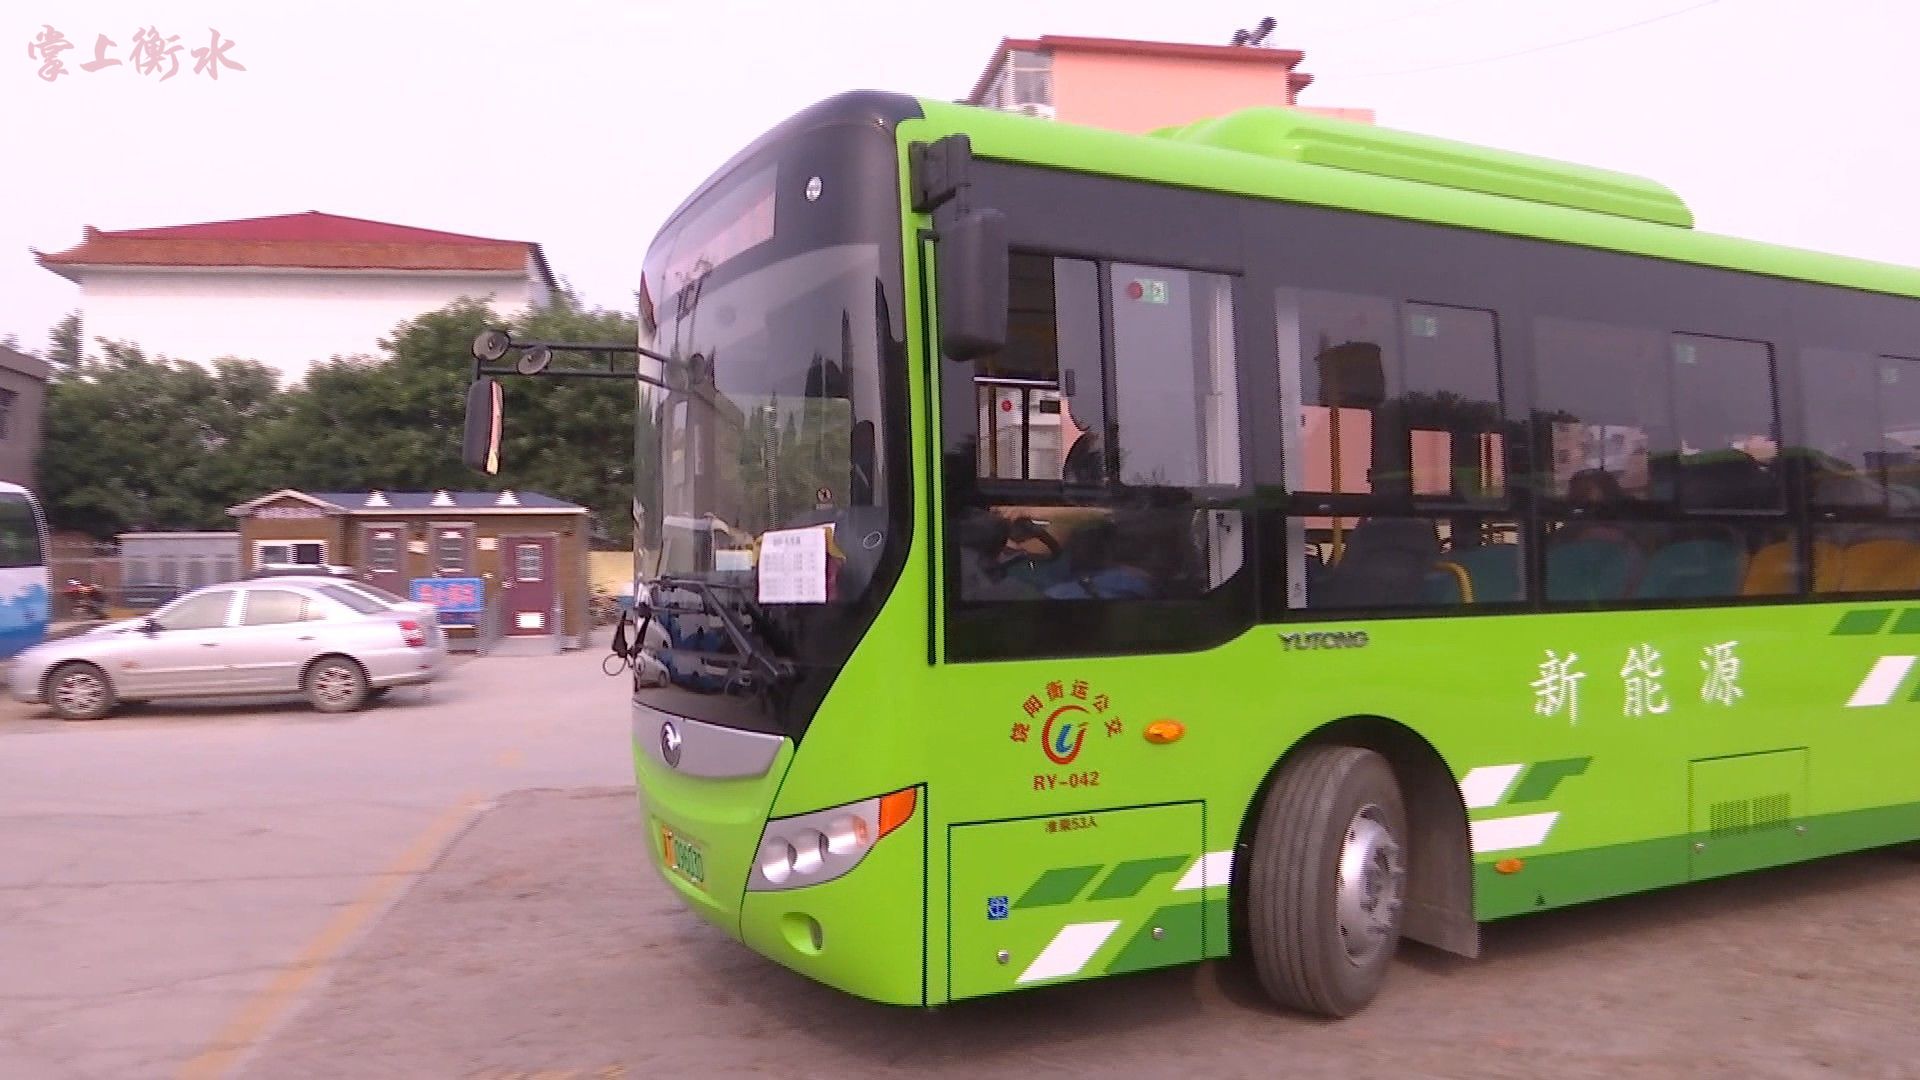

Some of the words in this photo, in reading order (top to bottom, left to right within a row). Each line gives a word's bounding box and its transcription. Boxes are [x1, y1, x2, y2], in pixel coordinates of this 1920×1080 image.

[1278, 631, 1369, 651] YUTONG
[1530, 641, 1744, 726] 新能源
[1010, 679, 1123, 743] 饶阳衡运公交
[1033, 771, 1100, 790] RY-042
